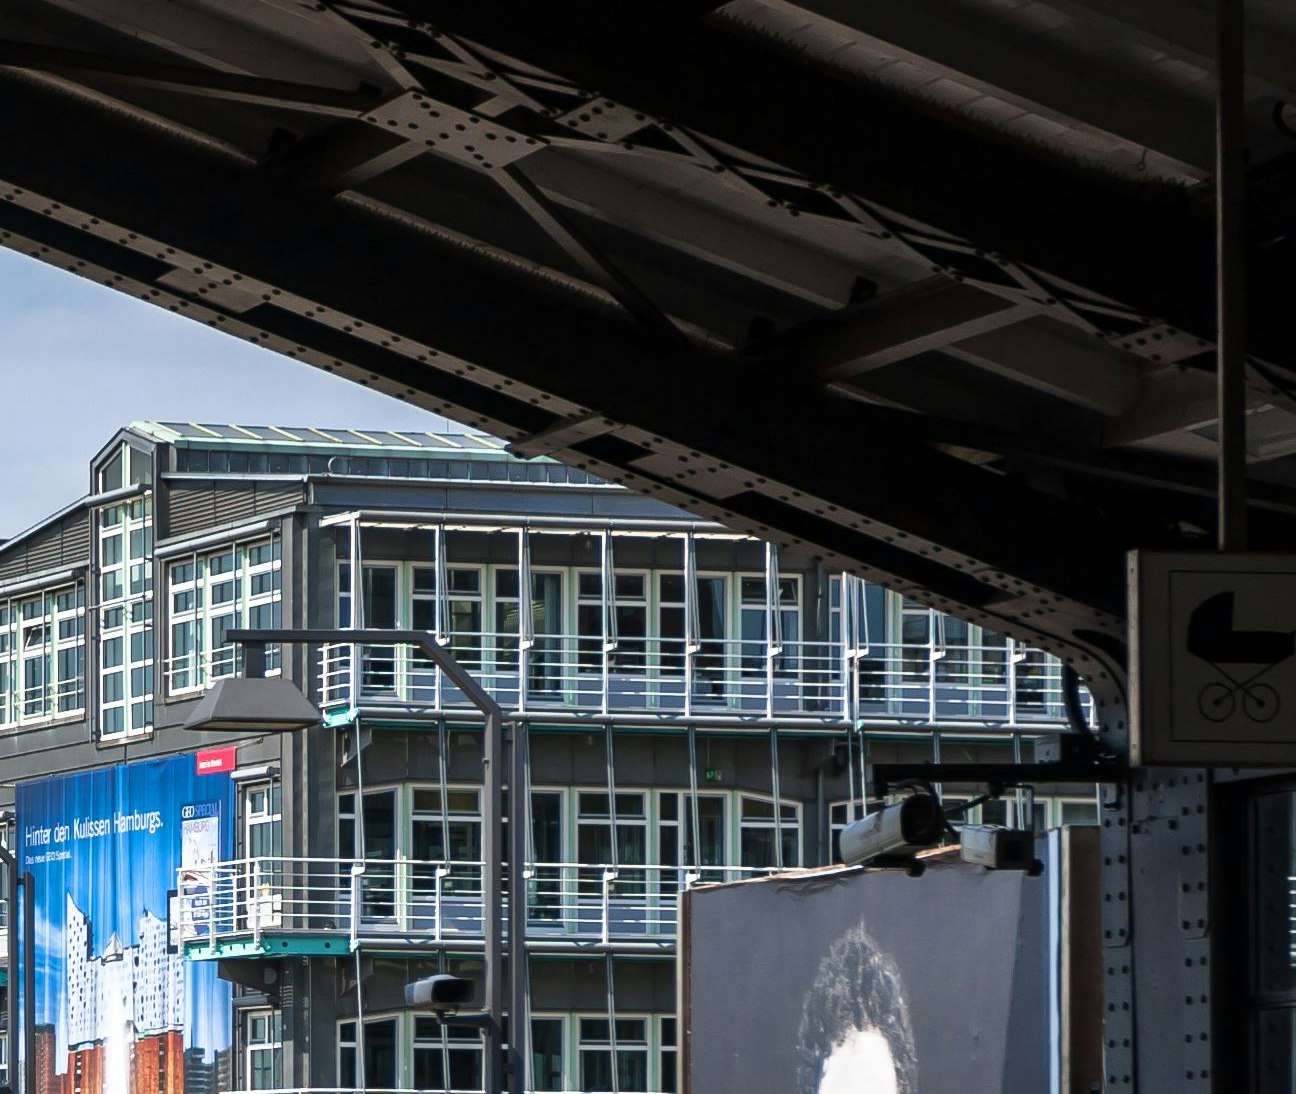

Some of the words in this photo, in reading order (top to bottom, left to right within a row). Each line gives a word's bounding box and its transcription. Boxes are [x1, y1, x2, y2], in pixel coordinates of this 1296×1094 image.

[25, 824, 52, 847] Hinter
[54, 824, 70, 843] den
[73, 815, 111, 840] Kulissen
[113, 809, 164, 834] Hamburgs.
